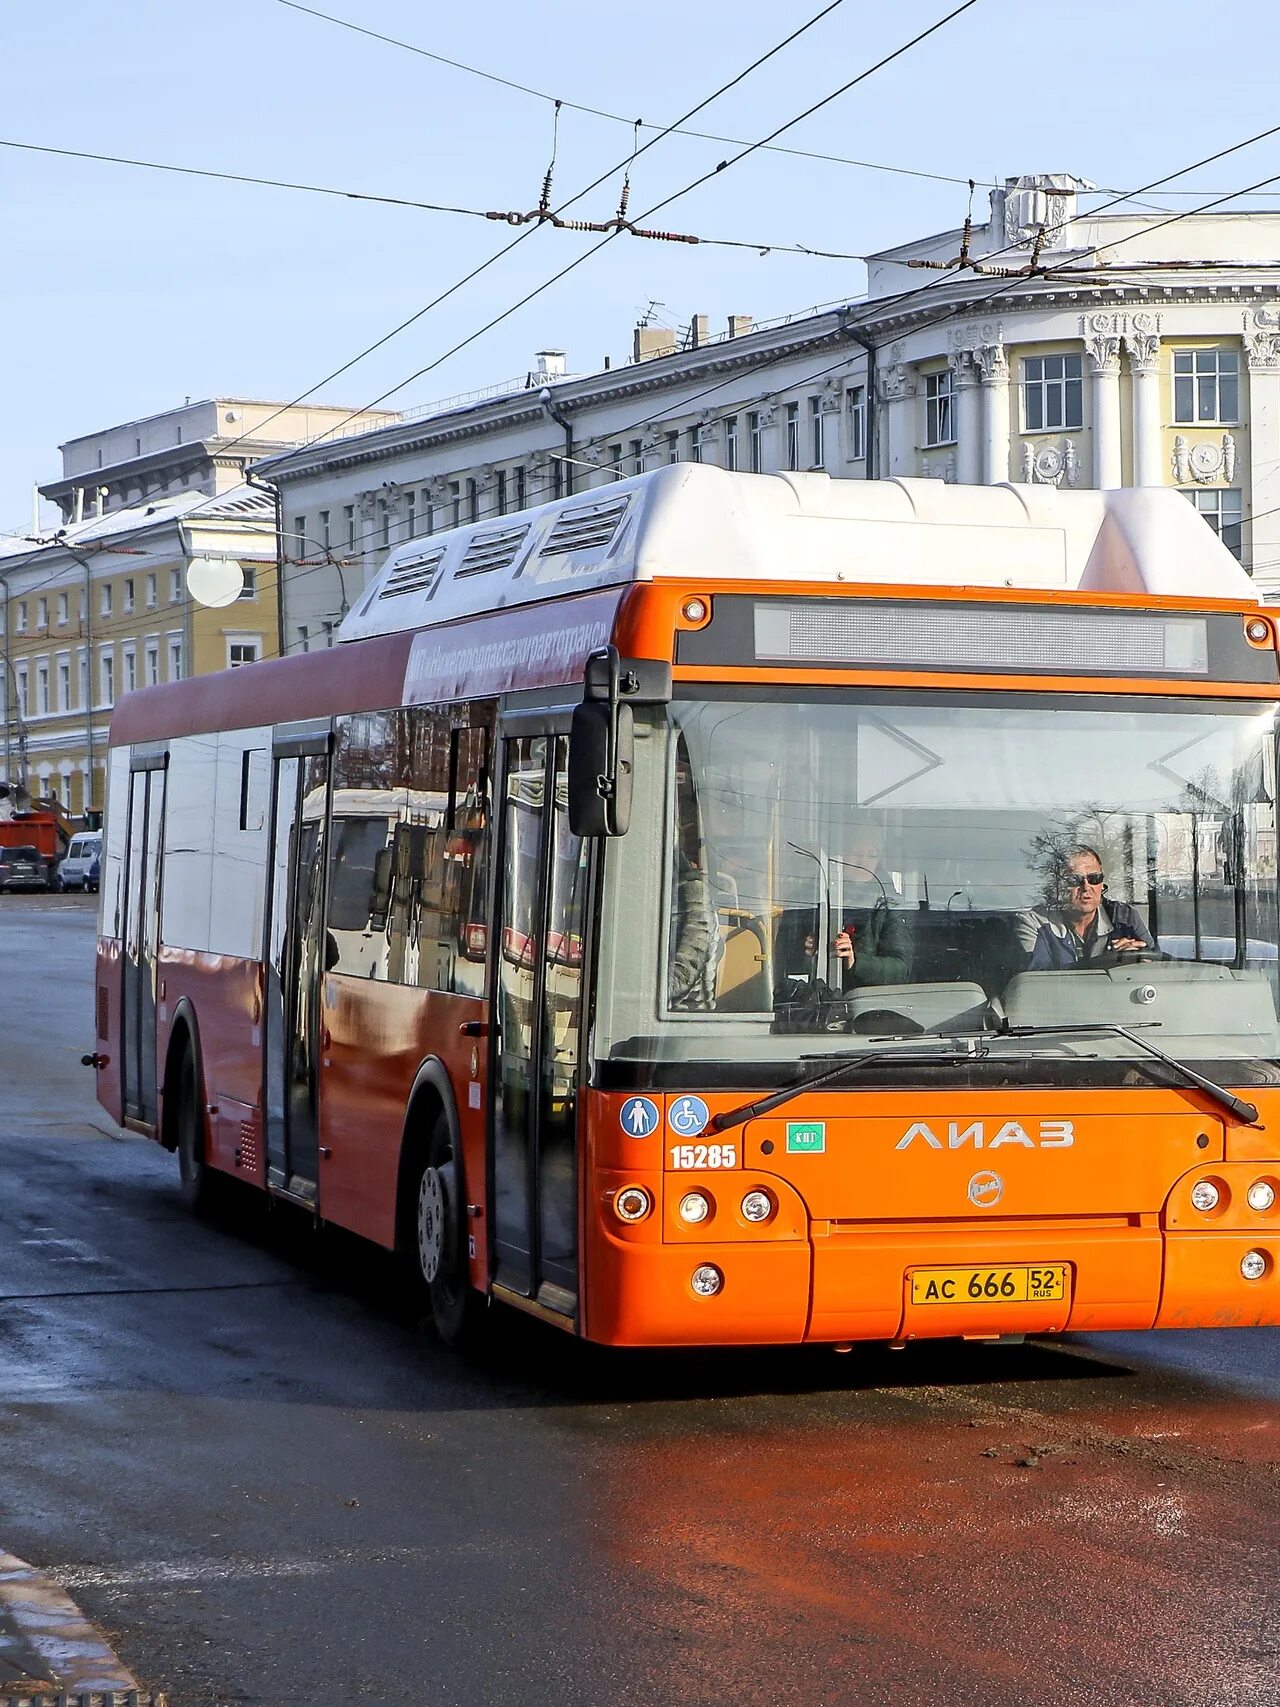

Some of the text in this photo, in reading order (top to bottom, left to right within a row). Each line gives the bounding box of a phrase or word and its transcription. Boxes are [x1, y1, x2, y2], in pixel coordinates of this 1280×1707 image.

[795, 1132, 817, 1144] КПГ
[894, 1120, 1076, 1150] ЛИАЗ
[670, 1144, 736, 1169] 15285
[967, 1272, 1016, 1298] 666
[1031, 1270, 1055, 1289] 52
[1033, 1289, 1052, 1297] RUS
